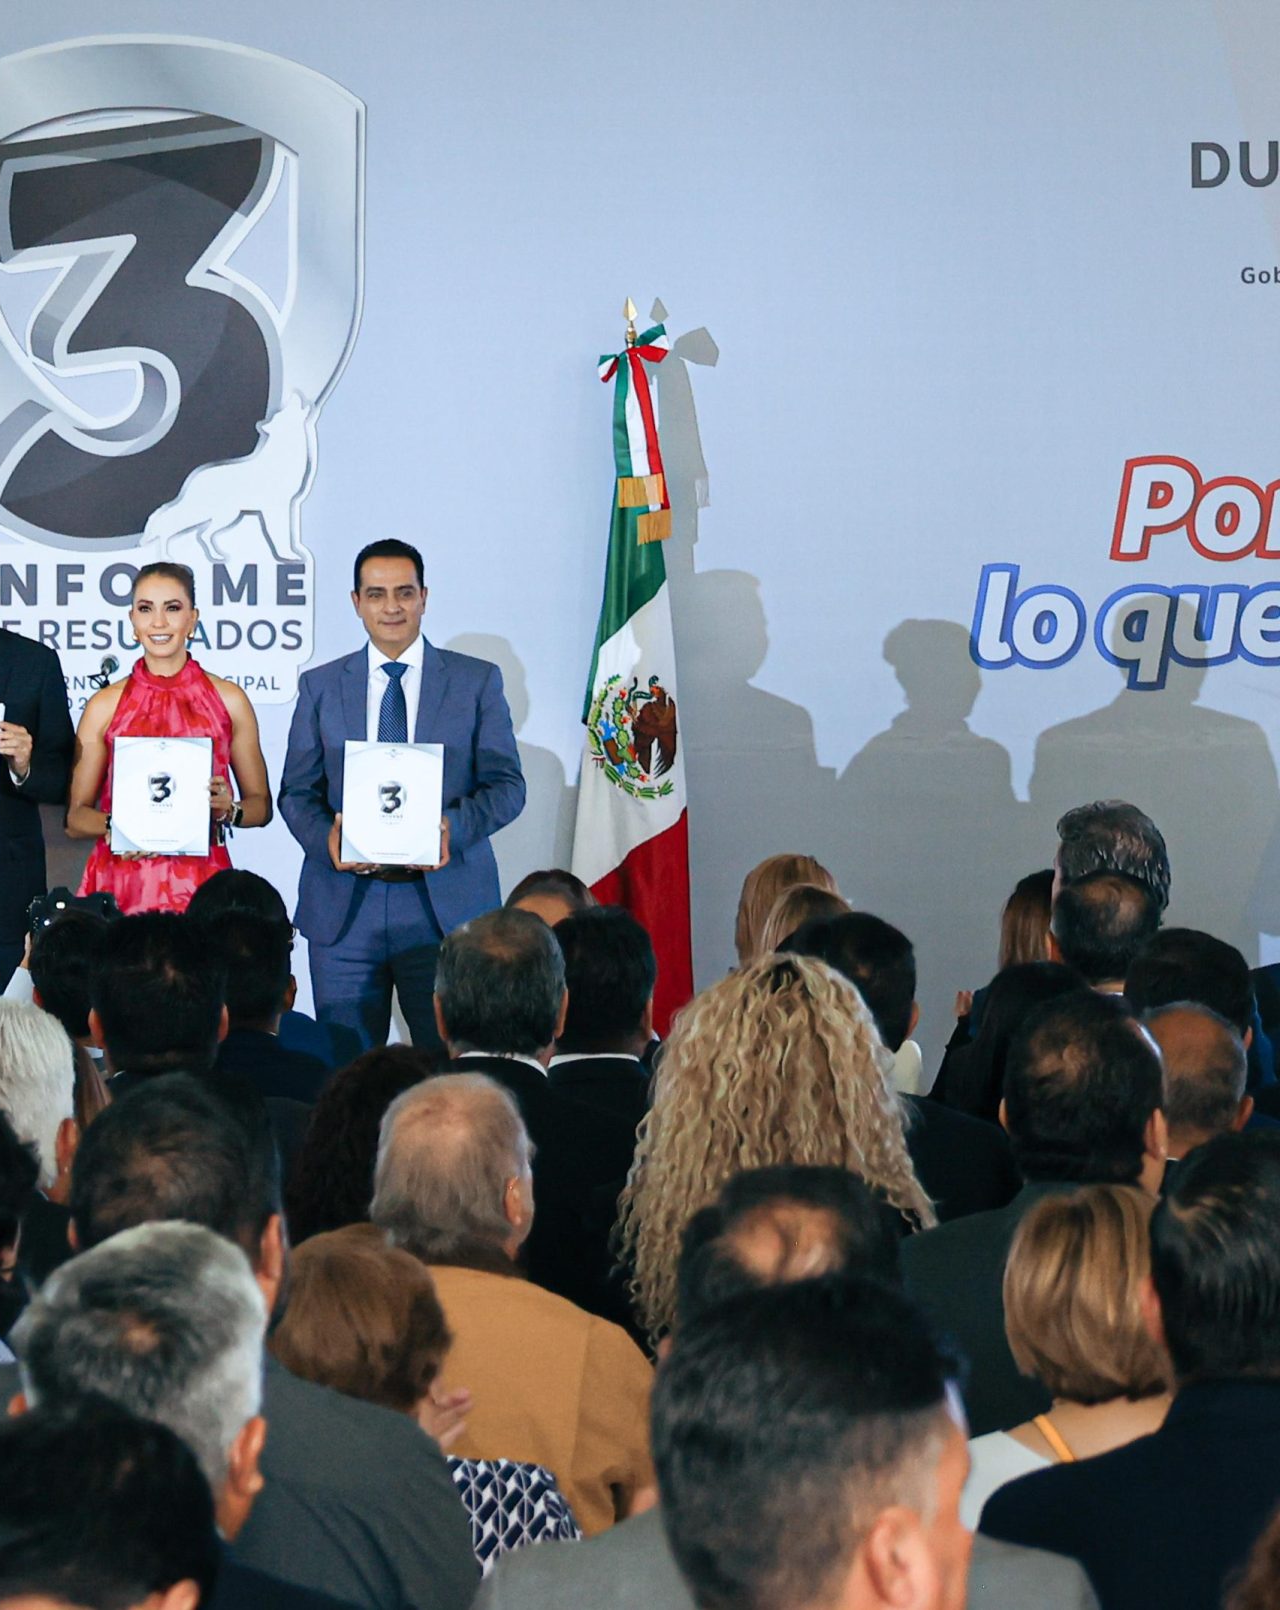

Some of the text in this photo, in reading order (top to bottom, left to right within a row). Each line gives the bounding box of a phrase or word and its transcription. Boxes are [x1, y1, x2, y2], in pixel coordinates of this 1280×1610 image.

[0, 562, 306, 607] NFOME
[39, 620, 303, 650] RESUADOS
[969, 563, 1280, 691] lo que
[150, 776, 171, 803] 3
[381, 785, 401, 813] 3
